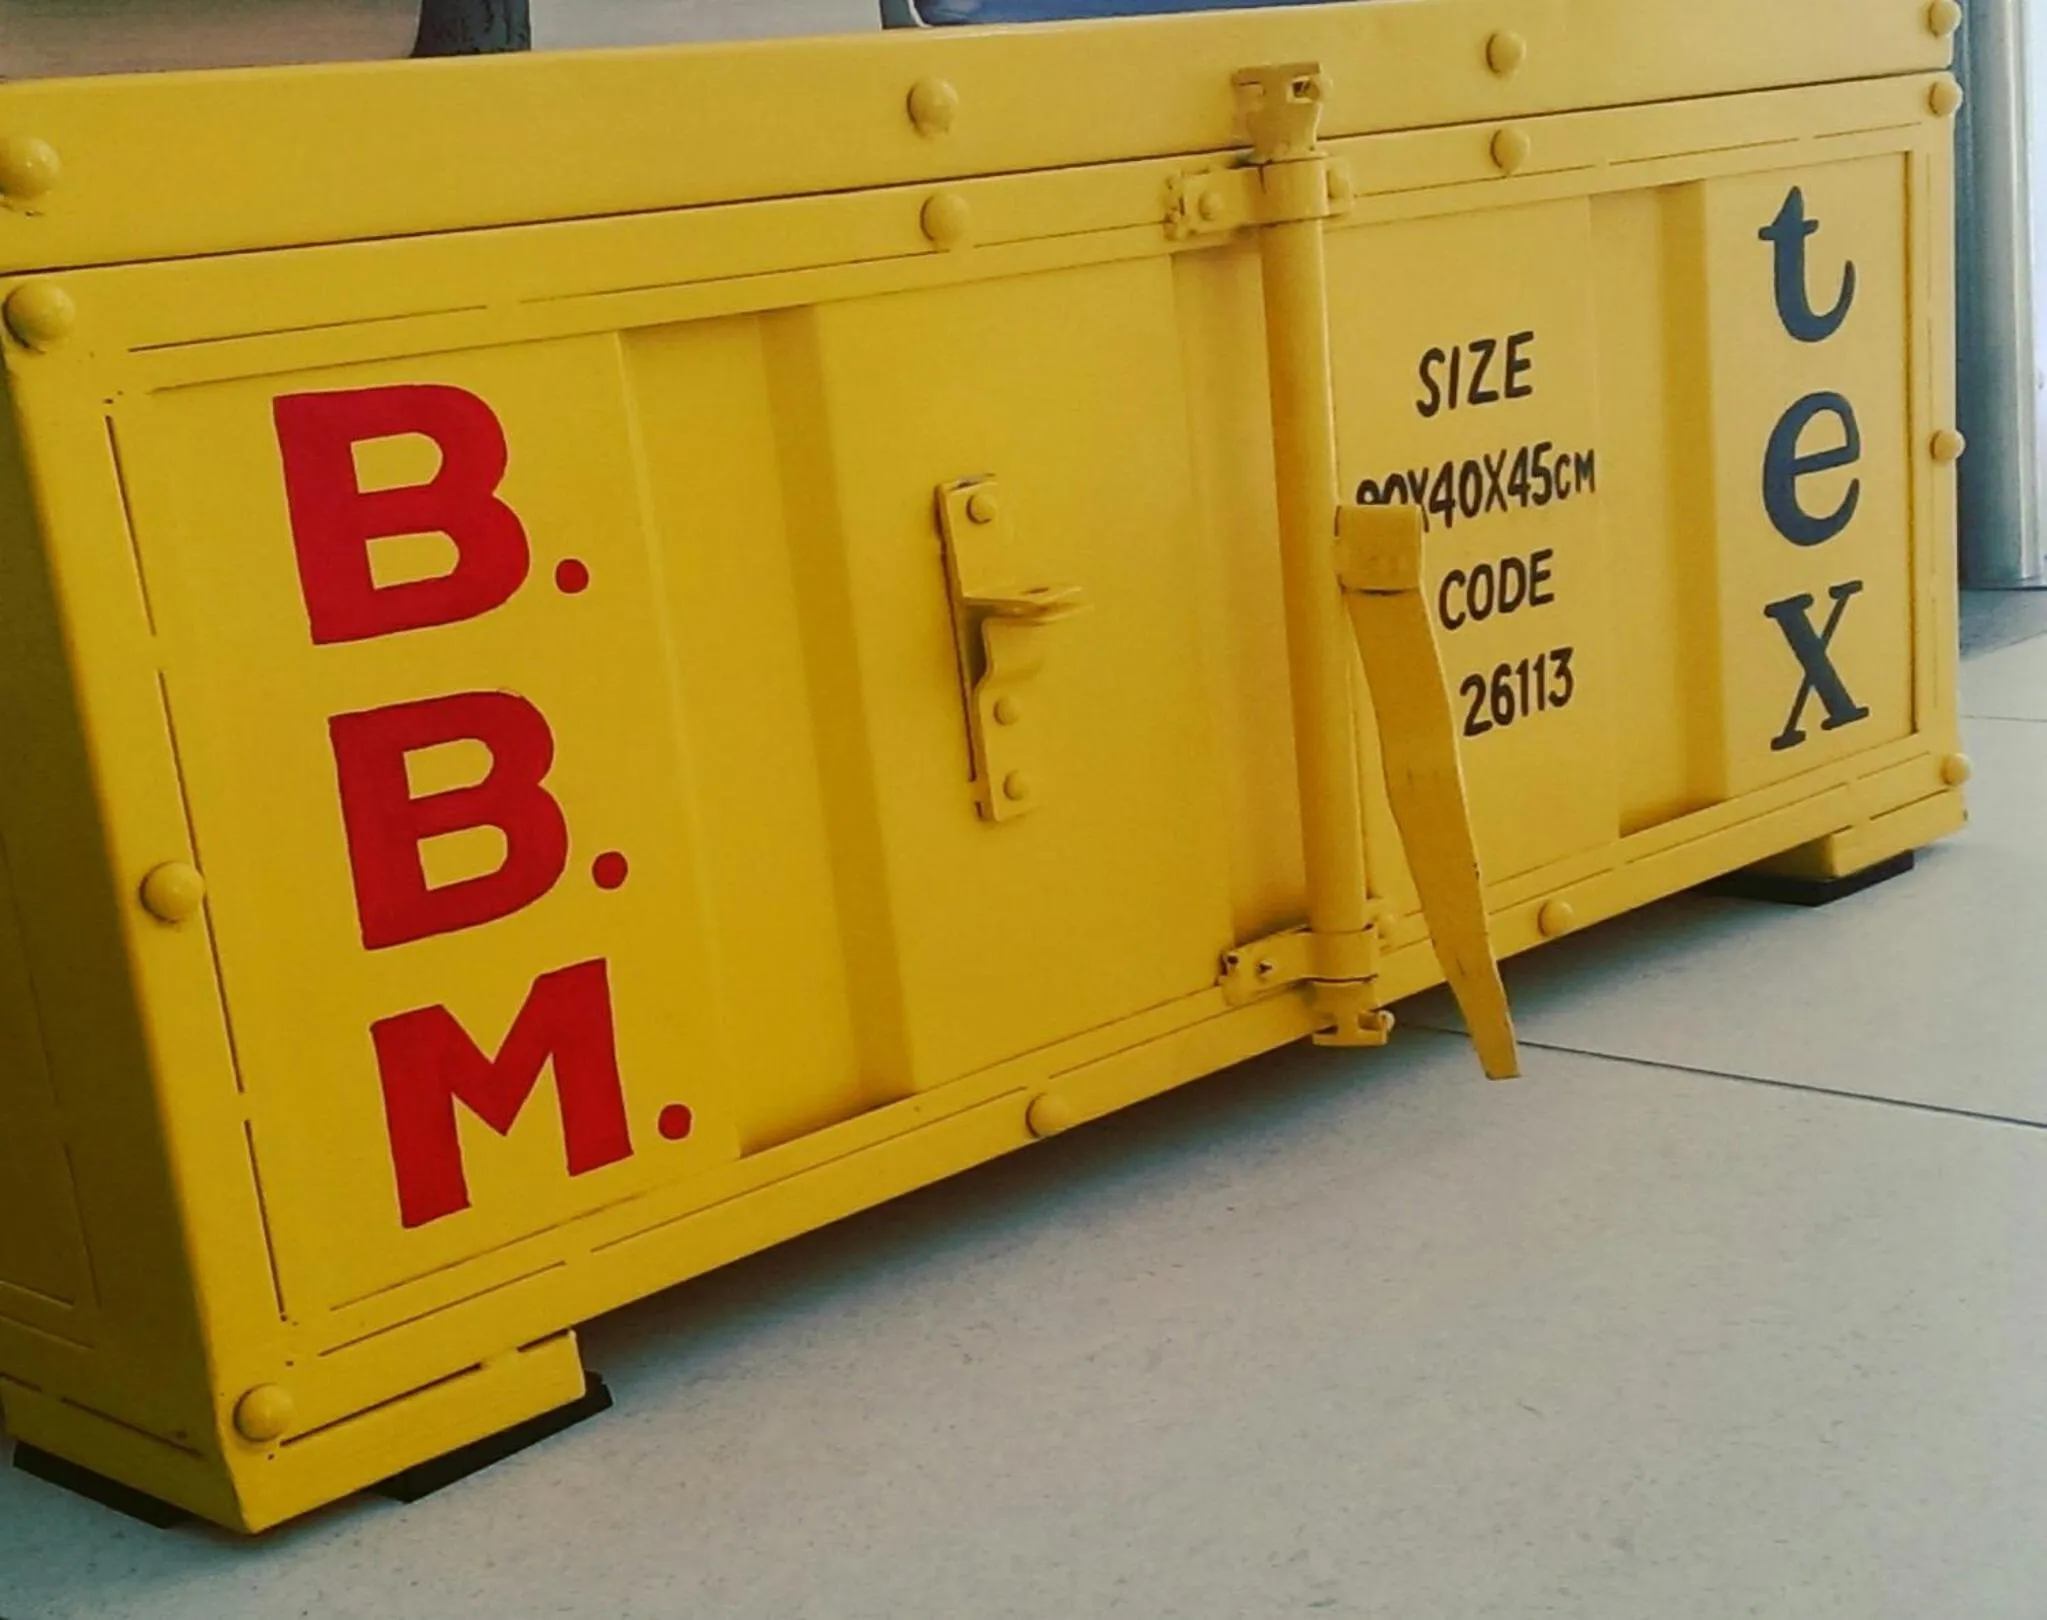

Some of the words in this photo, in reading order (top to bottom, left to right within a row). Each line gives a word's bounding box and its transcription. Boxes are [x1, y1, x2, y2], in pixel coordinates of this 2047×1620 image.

[1416, 330, 1535, 418] SIZE
[1758, 185, 1869, 752] tex
[1439, 548, 1555, 631] CODE
[1459, 646, 1574, 738] 26113
